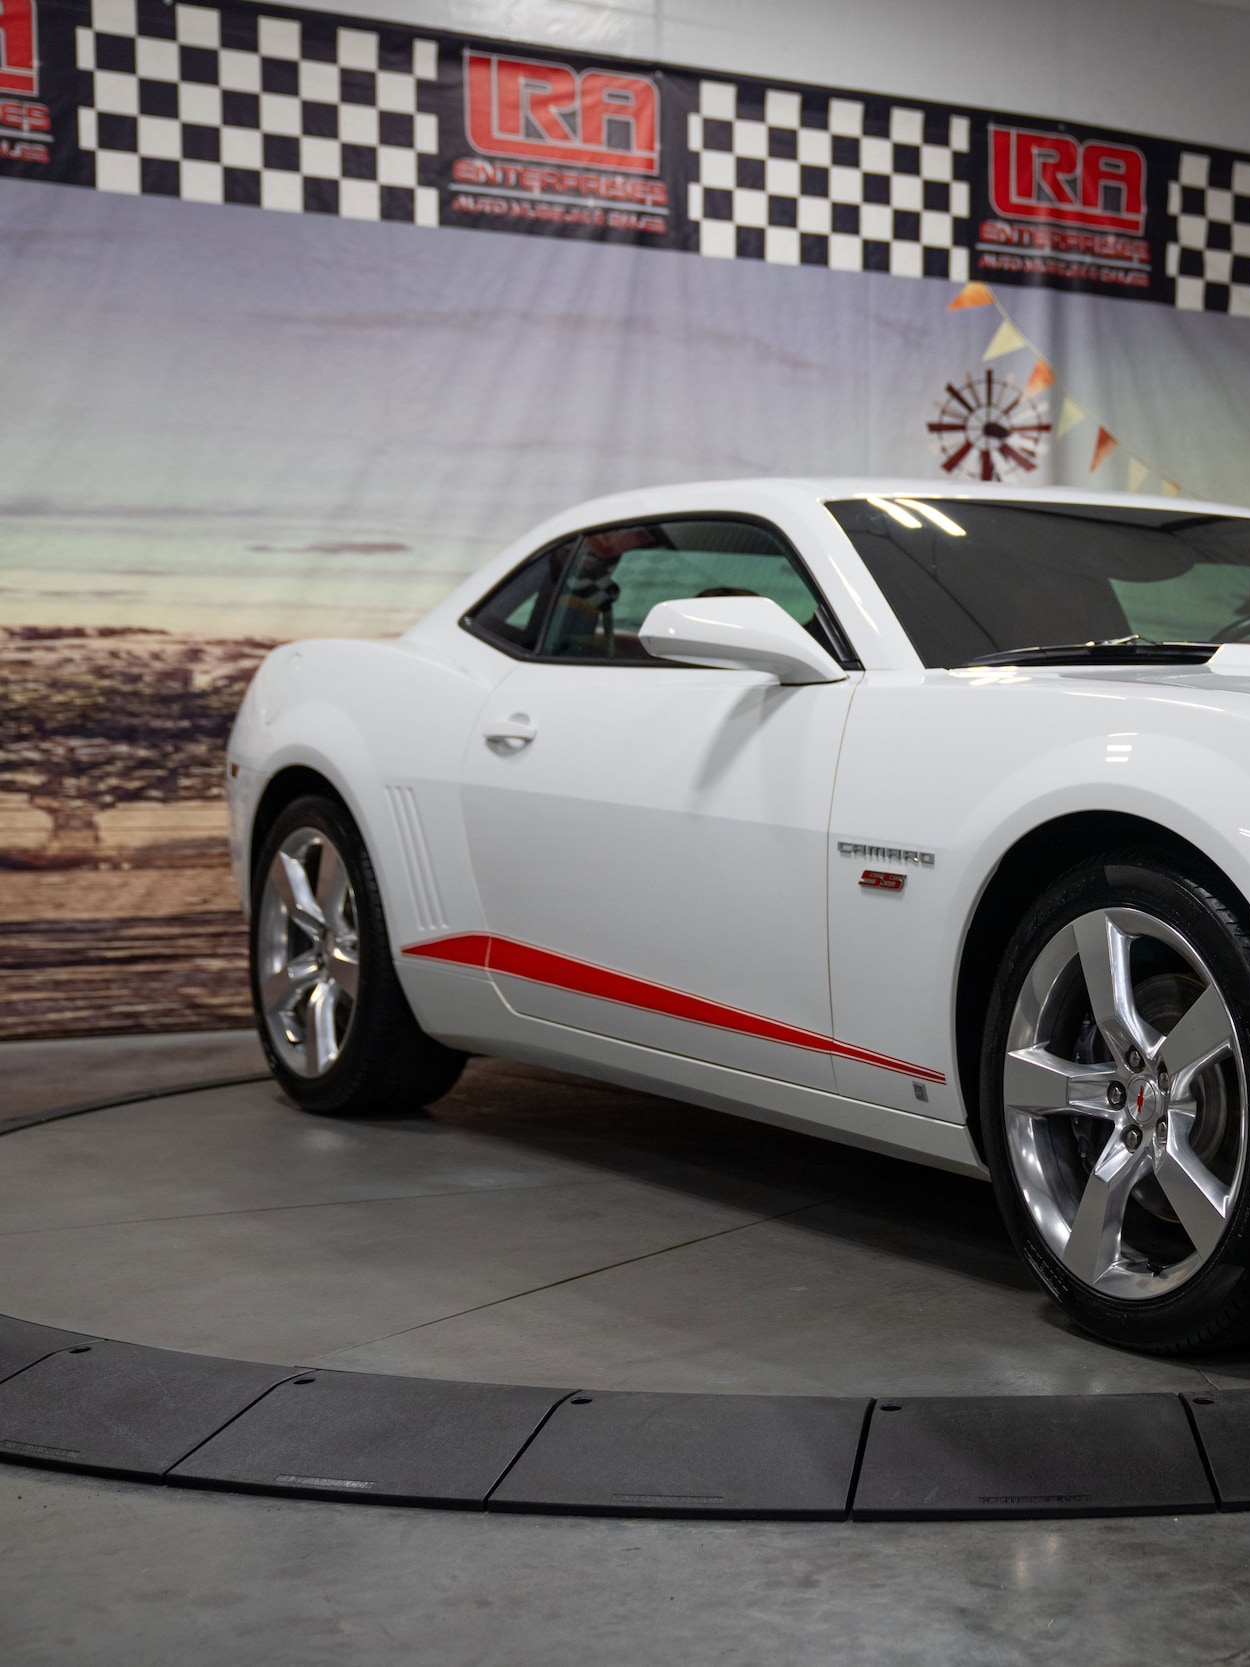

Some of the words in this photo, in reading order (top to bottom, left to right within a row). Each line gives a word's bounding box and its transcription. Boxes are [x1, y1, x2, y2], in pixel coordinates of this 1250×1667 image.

[464, 48, 661, 176] LRA
[453, 157, 669, 205] ENTERPRISES
[989, 124, 1147, 237] LRA
[838, 841, 935, 865] CAMARO
[858, 869, 907, 891] SS
